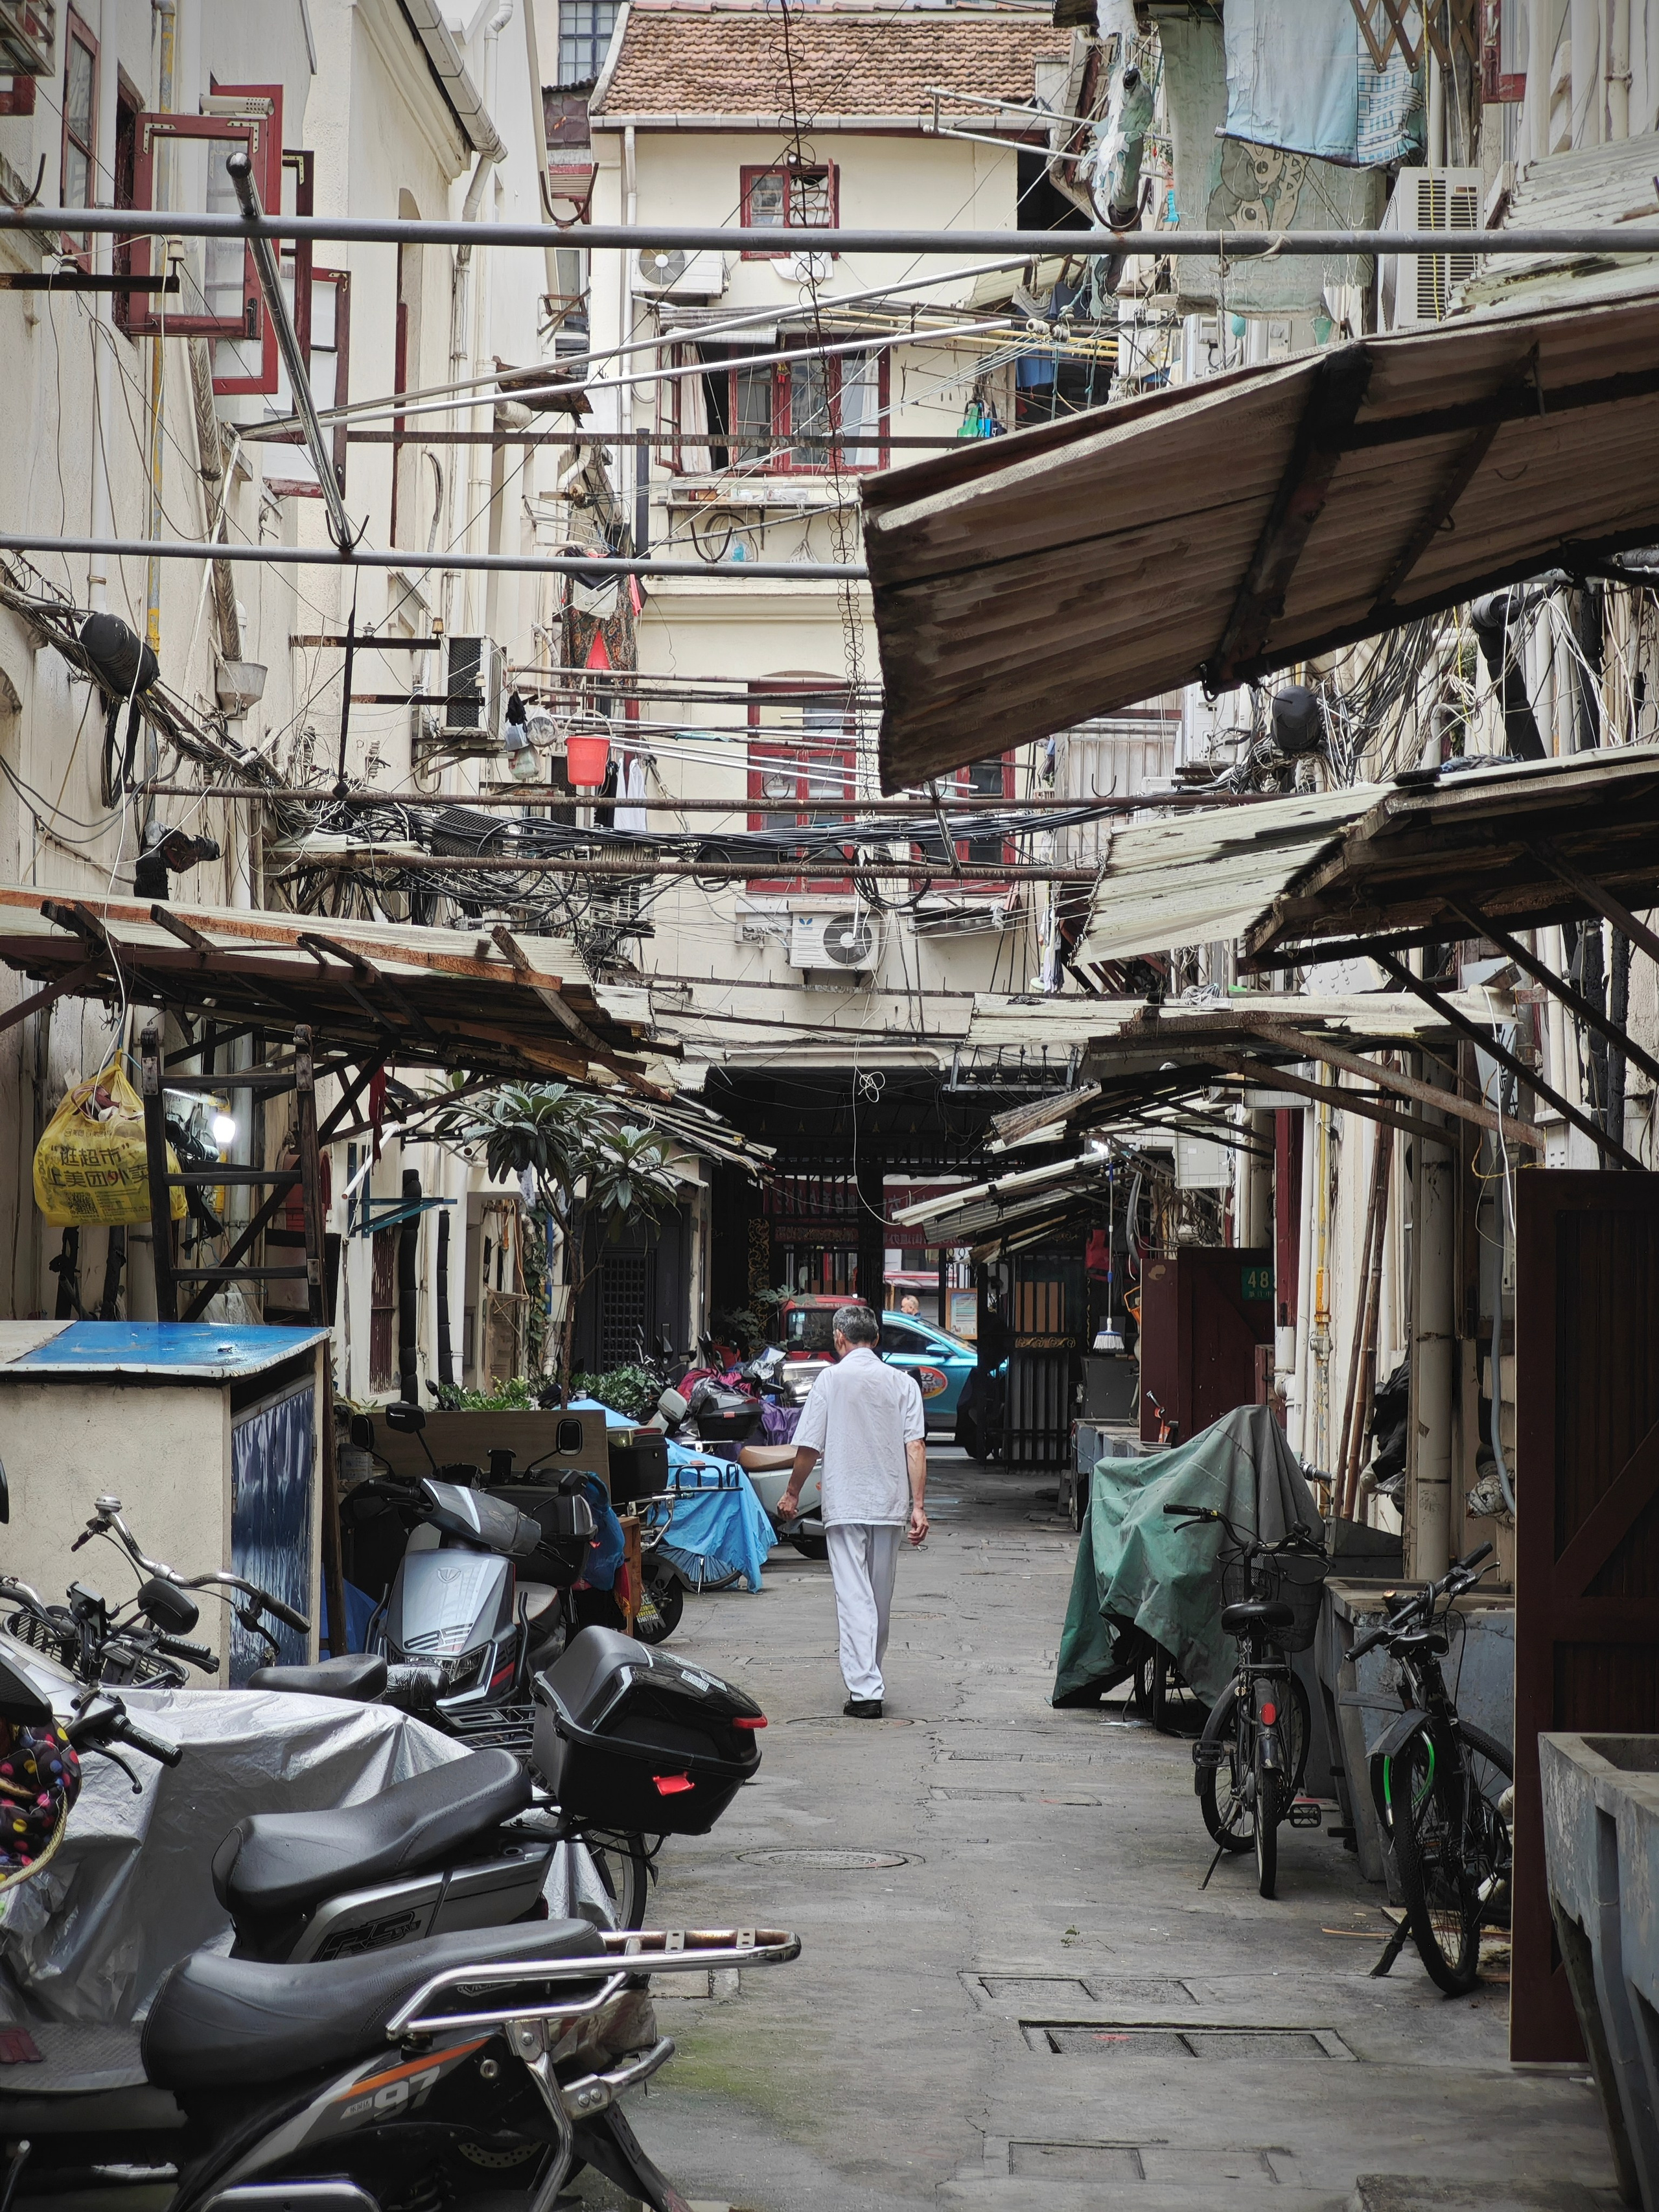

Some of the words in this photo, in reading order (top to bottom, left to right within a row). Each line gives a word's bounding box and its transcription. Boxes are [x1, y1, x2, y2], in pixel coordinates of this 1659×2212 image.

[49, 1163, 149, 1187] 上美团外卖
[374, 2066, 440, 2122] 97
